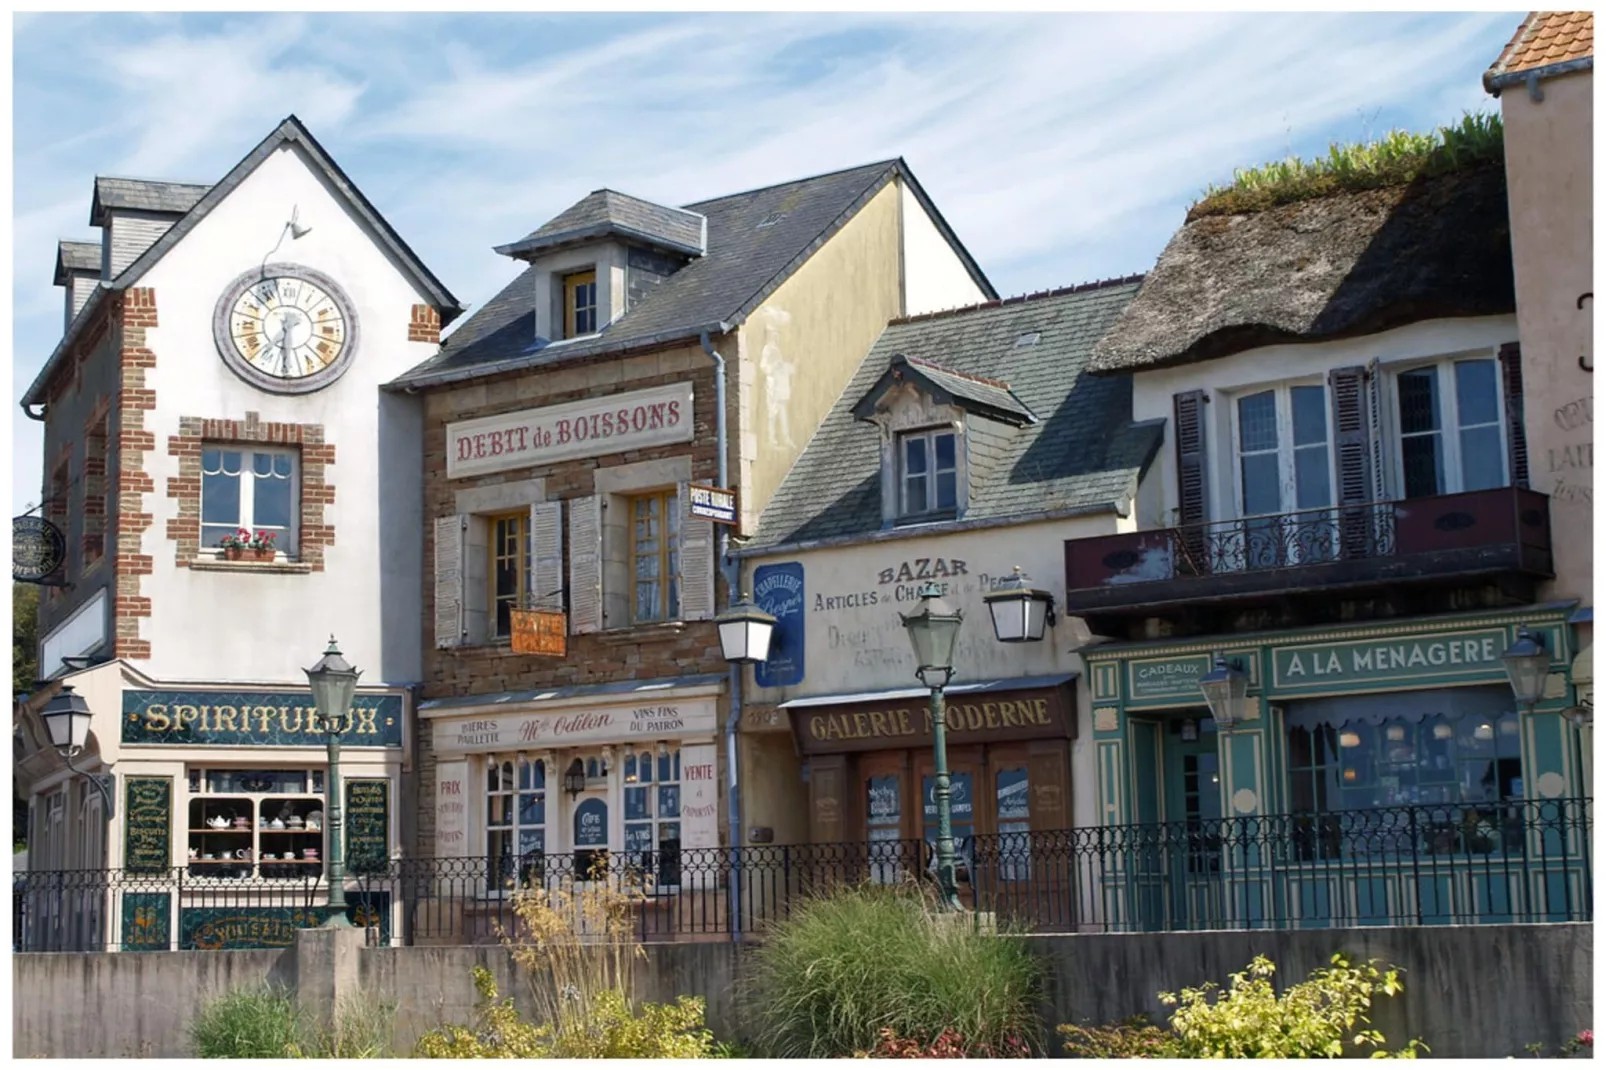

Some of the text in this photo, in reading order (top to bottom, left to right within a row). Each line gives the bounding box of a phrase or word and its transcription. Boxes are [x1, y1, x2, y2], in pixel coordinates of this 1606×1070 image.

[456, 400, 680, 461] DEBIT de BOISSONS
[878, 557, 969, 585] BAZAR
[813, 590, 878, 612] ARTICLES
[1286, 637, 1496, 677] A LA MENAGERE
[1138, 662, 1199, 679] CADEAUX
[632, 705, 679, 720] VINS FINS
[629, 717, 684, 732] DU PATRON
[809, 708, 916, 741] GALERIE
[684, 764, 713, 781] VENTE
[441, 779, 461, 796] PRIX
